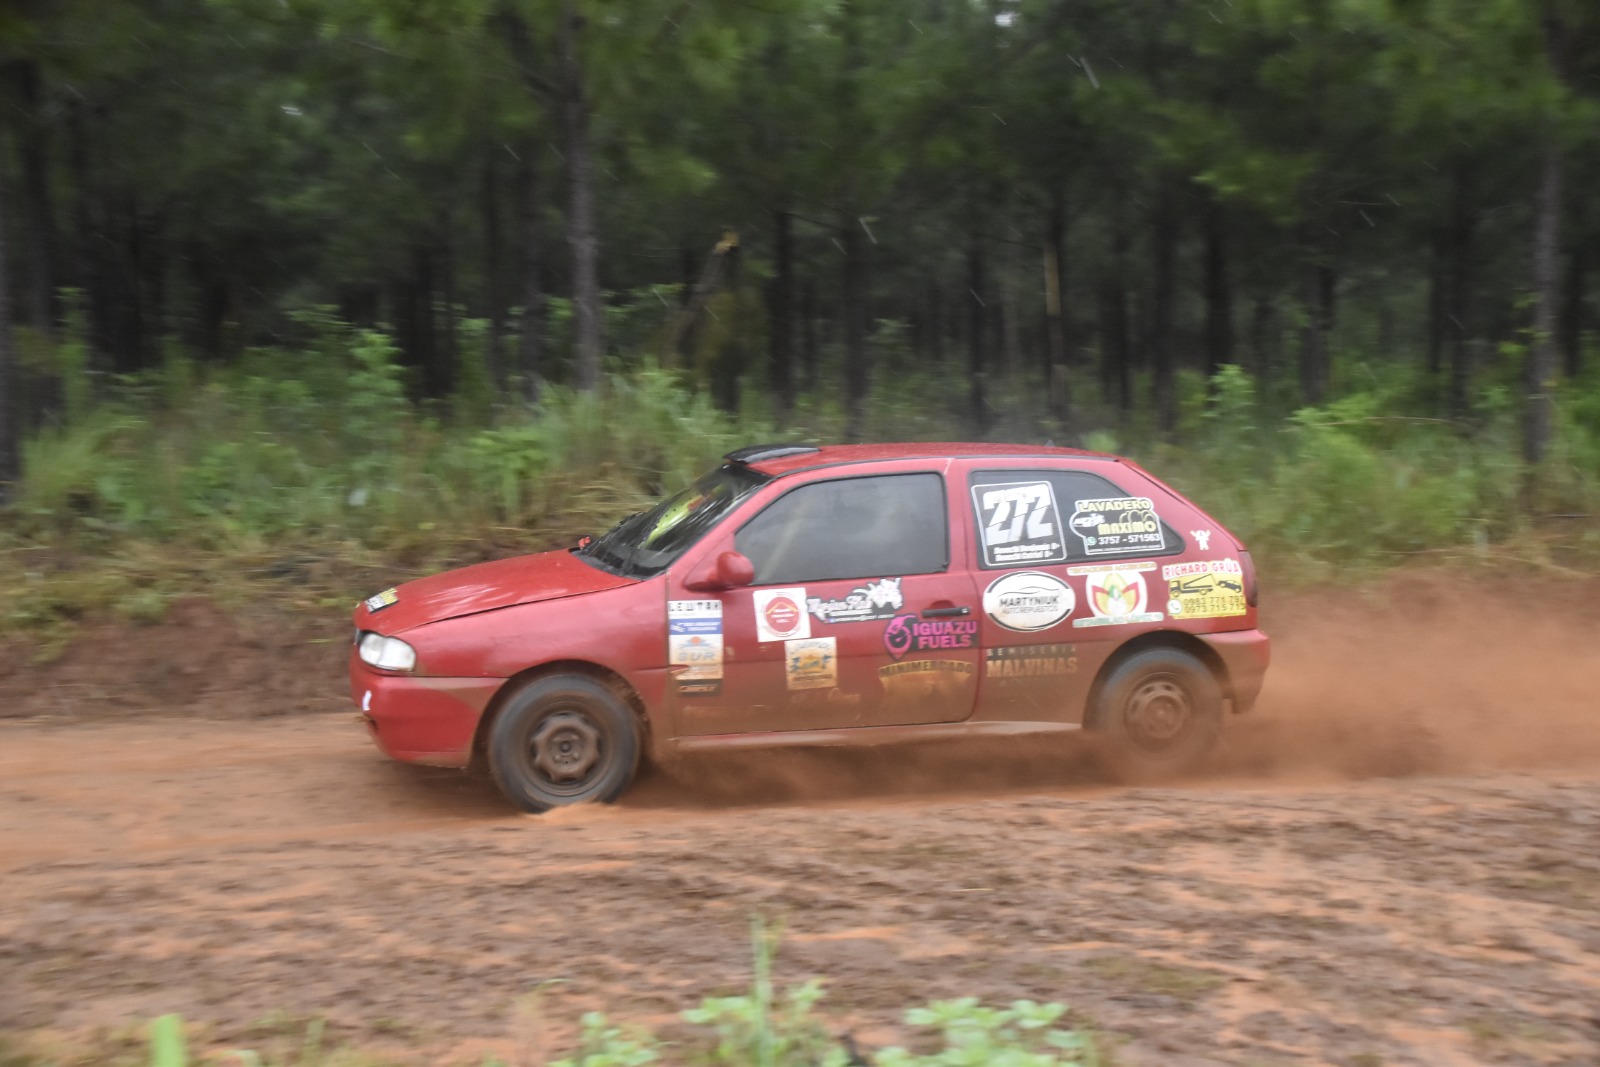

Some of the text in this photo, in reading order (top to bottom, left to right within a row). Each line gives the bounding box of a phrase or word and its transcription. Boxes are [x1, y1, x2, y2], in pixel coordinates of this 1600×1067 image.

[1079, 500, 1151, 512] LAVADERO
[983, 484, 1053, 546] 272
[1098, 520, 1156, 535] MAXIMO
[1098, 535, 1120, 545] 3757
[1164, 562, 1208, 577] RICHARD
[1000, 595, 1059, 607] MARTYNIUK
[913, 621, 977, 636] IGUAZU
[918, 634, 971, 649] FUELS
[986, 658, 1079, 677] MALVINAS
